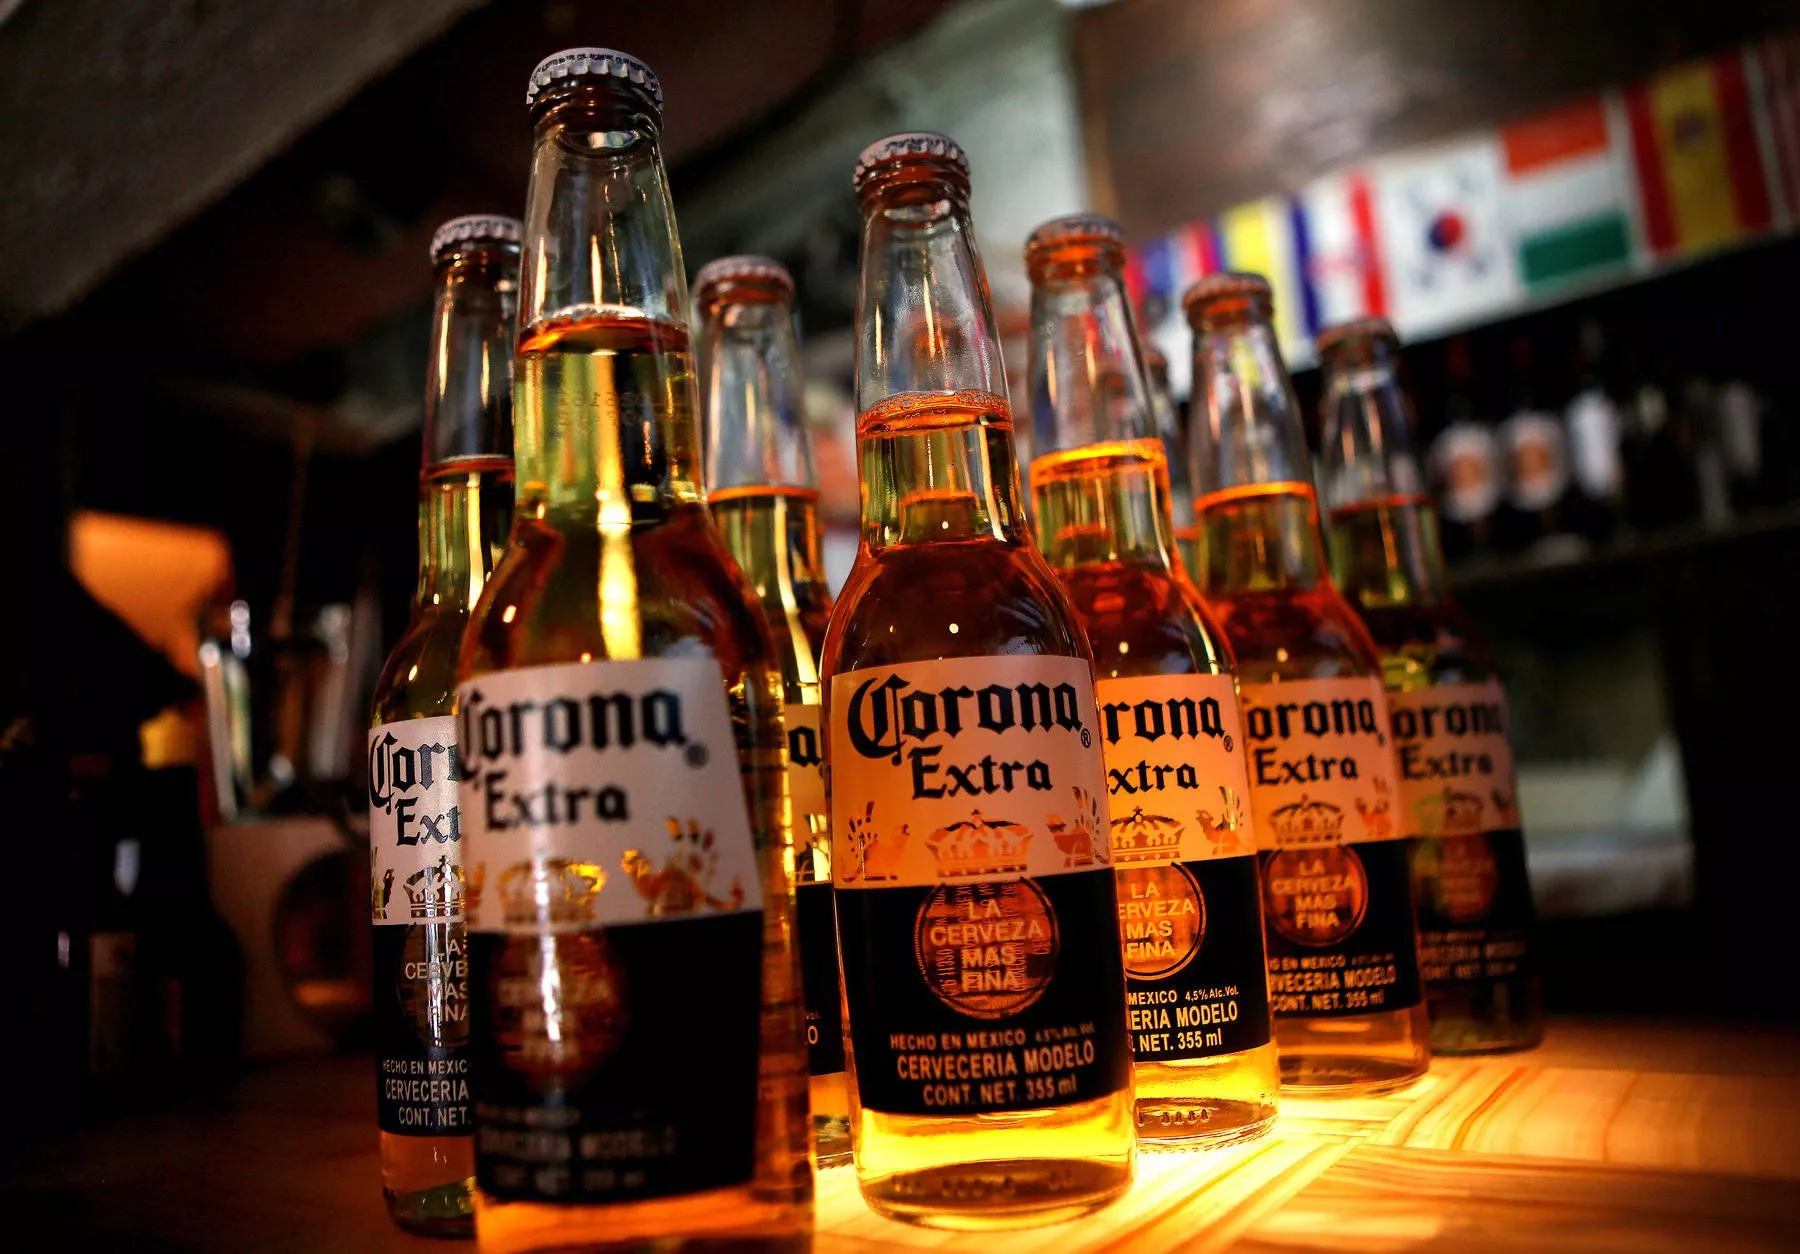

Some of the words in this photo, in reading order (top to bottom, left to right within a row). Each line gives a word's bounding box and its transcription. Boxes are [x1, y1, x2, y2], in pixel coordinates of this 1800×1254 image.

[848, 673, 1082, 765] Corona
[1103, 697, 1225, 745] rona
[1243, 697, 1378, 740] orona
[460, 687, 686, 790] Corona
[907, 745, 1053, 800] Extra
[1108, 759, 1199, 795] xtra
[1254, 747, 1359, 786] Extra
[485, 770, 628, 832] Extra
[1131, 882, 1160, 899] LA
[968, 899, 1001, 920] LA
[930, 920, 1043, 946] CERVEZA
[1126, 920, 1173, 939] MAS
[961, 946, 1017, 969] MAS
[1126, 940, 1176, 960] FINA
[961, 969, 1021, 993] FINA
[1128, 990, 1178, 1005] MEXICO
[1176, 1000, 1239, 1028] MODELO
[890, 1034, 936, 1050] HECHO
[941, 1033, 961, 1050] EN
[966, 1028, 1026, 1049] MEXICO
[1139, 1033, 1174, 1052] NET.
[1177, 1030, 1203, 1050] 355
[1206, 1028, 1222, 1047] ml
[383, 1060, 408, 1075] HECHO
[411, 1061, 424, 1075] EN
[428, 1060, 471, 1075] MEXIC
[897, 1052, 1018, 1080] CERVECERIA
[1024, 1039, 1095, 1074] MODELO
[385, 1078, 469, 1102] CERVECERIA
[1026, 1076, 1055, 1101] 355
[1058, 1073, 1077, 1095] ml
